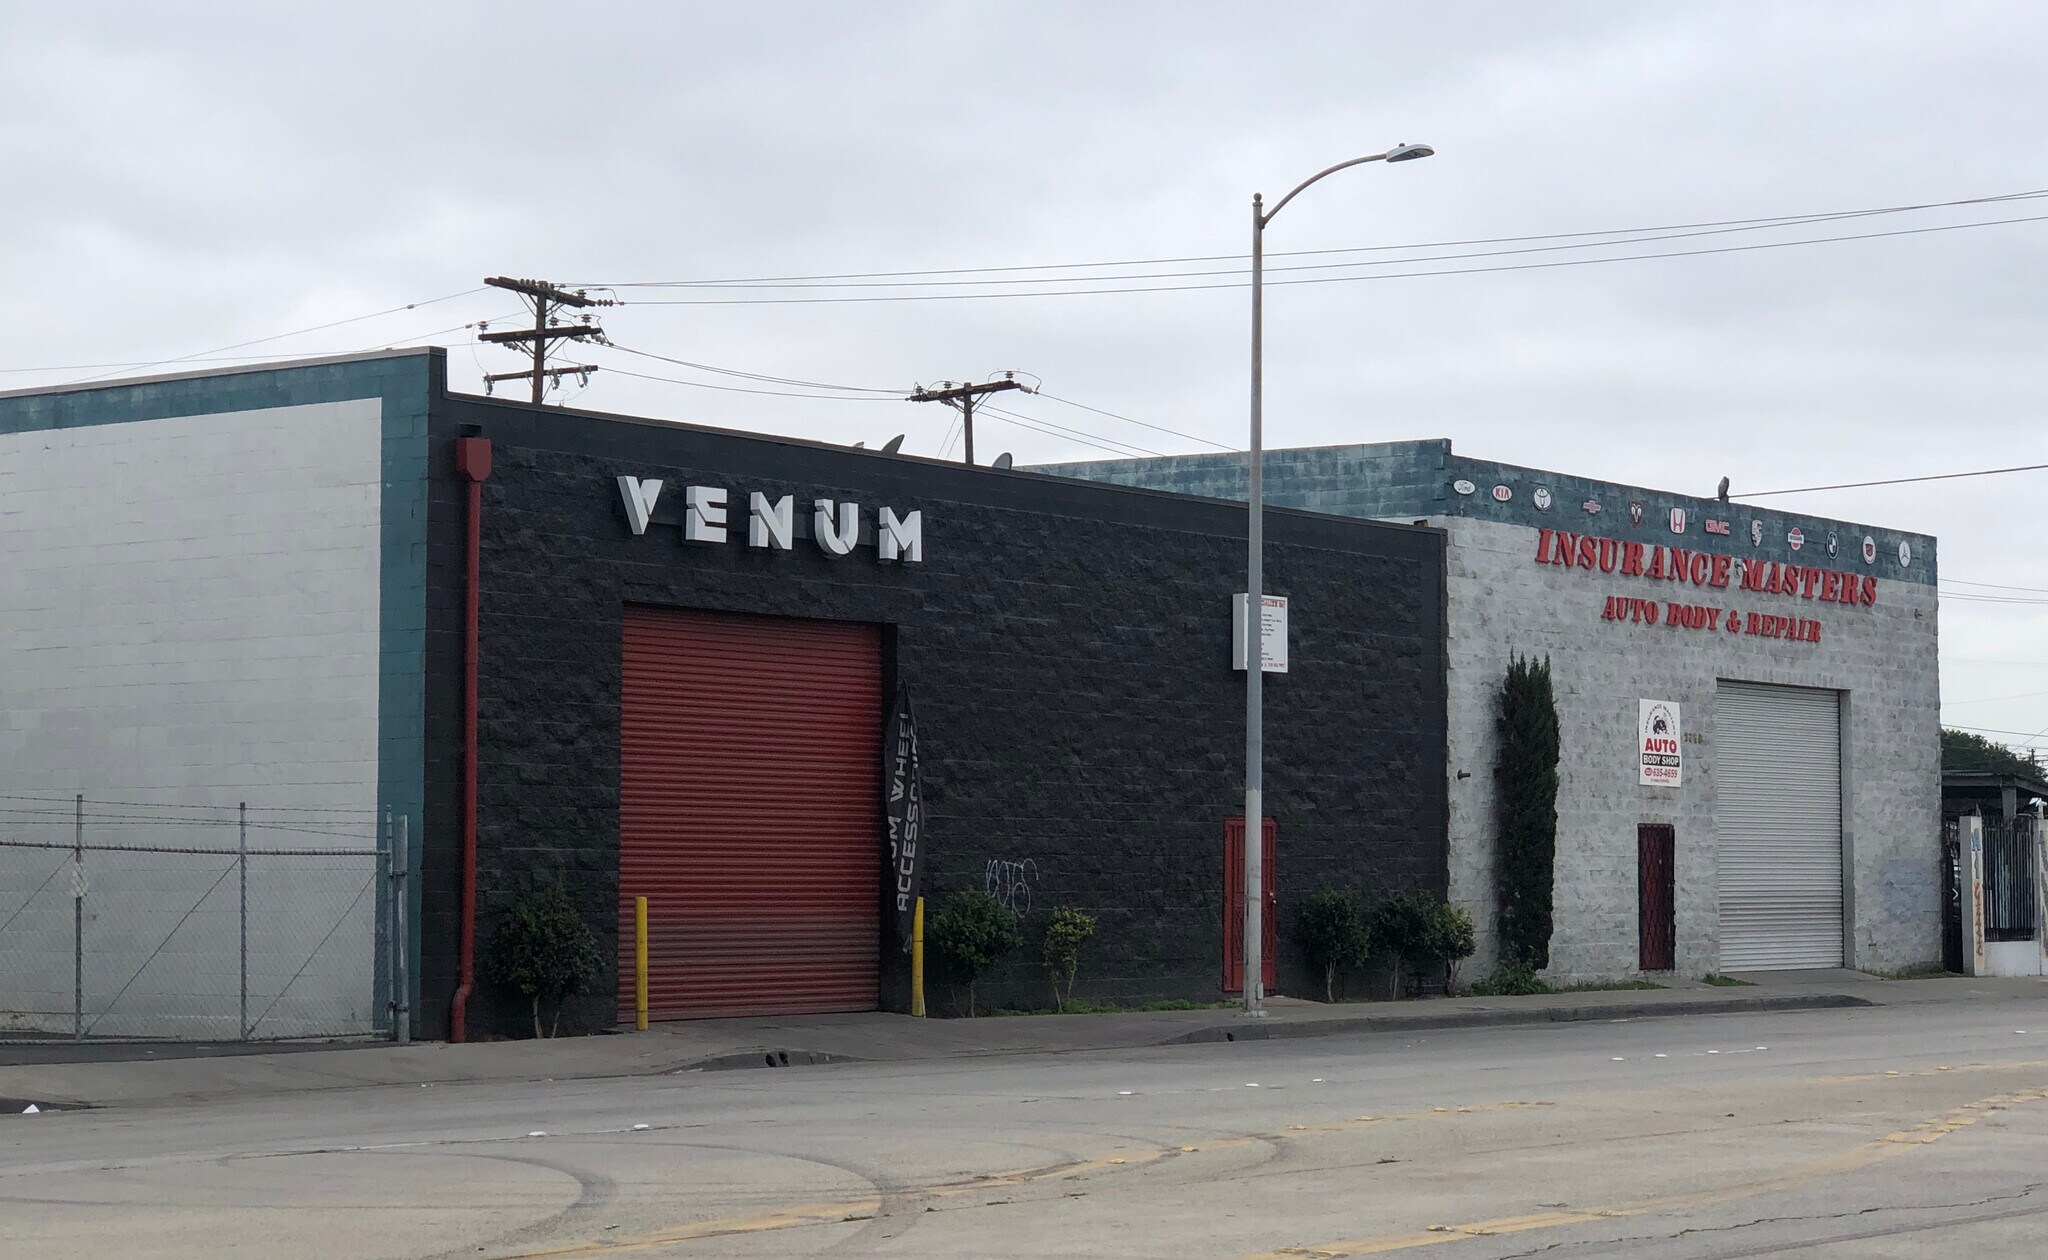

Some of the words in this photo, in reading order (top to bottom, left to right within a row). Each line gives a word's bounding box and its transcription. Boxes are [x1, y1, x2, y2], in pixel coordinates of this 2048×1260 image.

[616, 475, 922, 562] VENUM
[1705, 519, 1730, 535] GMC
[1535, 528, 1732, 588] INSURANCE
[1739, 557, 1878, 607] MASTERS
[1601, 595, 1659, 625] AUTO
[1666, 602, 1722, 631] BODY
[1726, 609, 1742, 634] &
[1745, 611, 1821, 643] REPAIR
[1643, 754, 1661, 765] BODY
[1661, 756, 1679, 766] SHOP
[1645, 738, 1677, 754] AUTO
